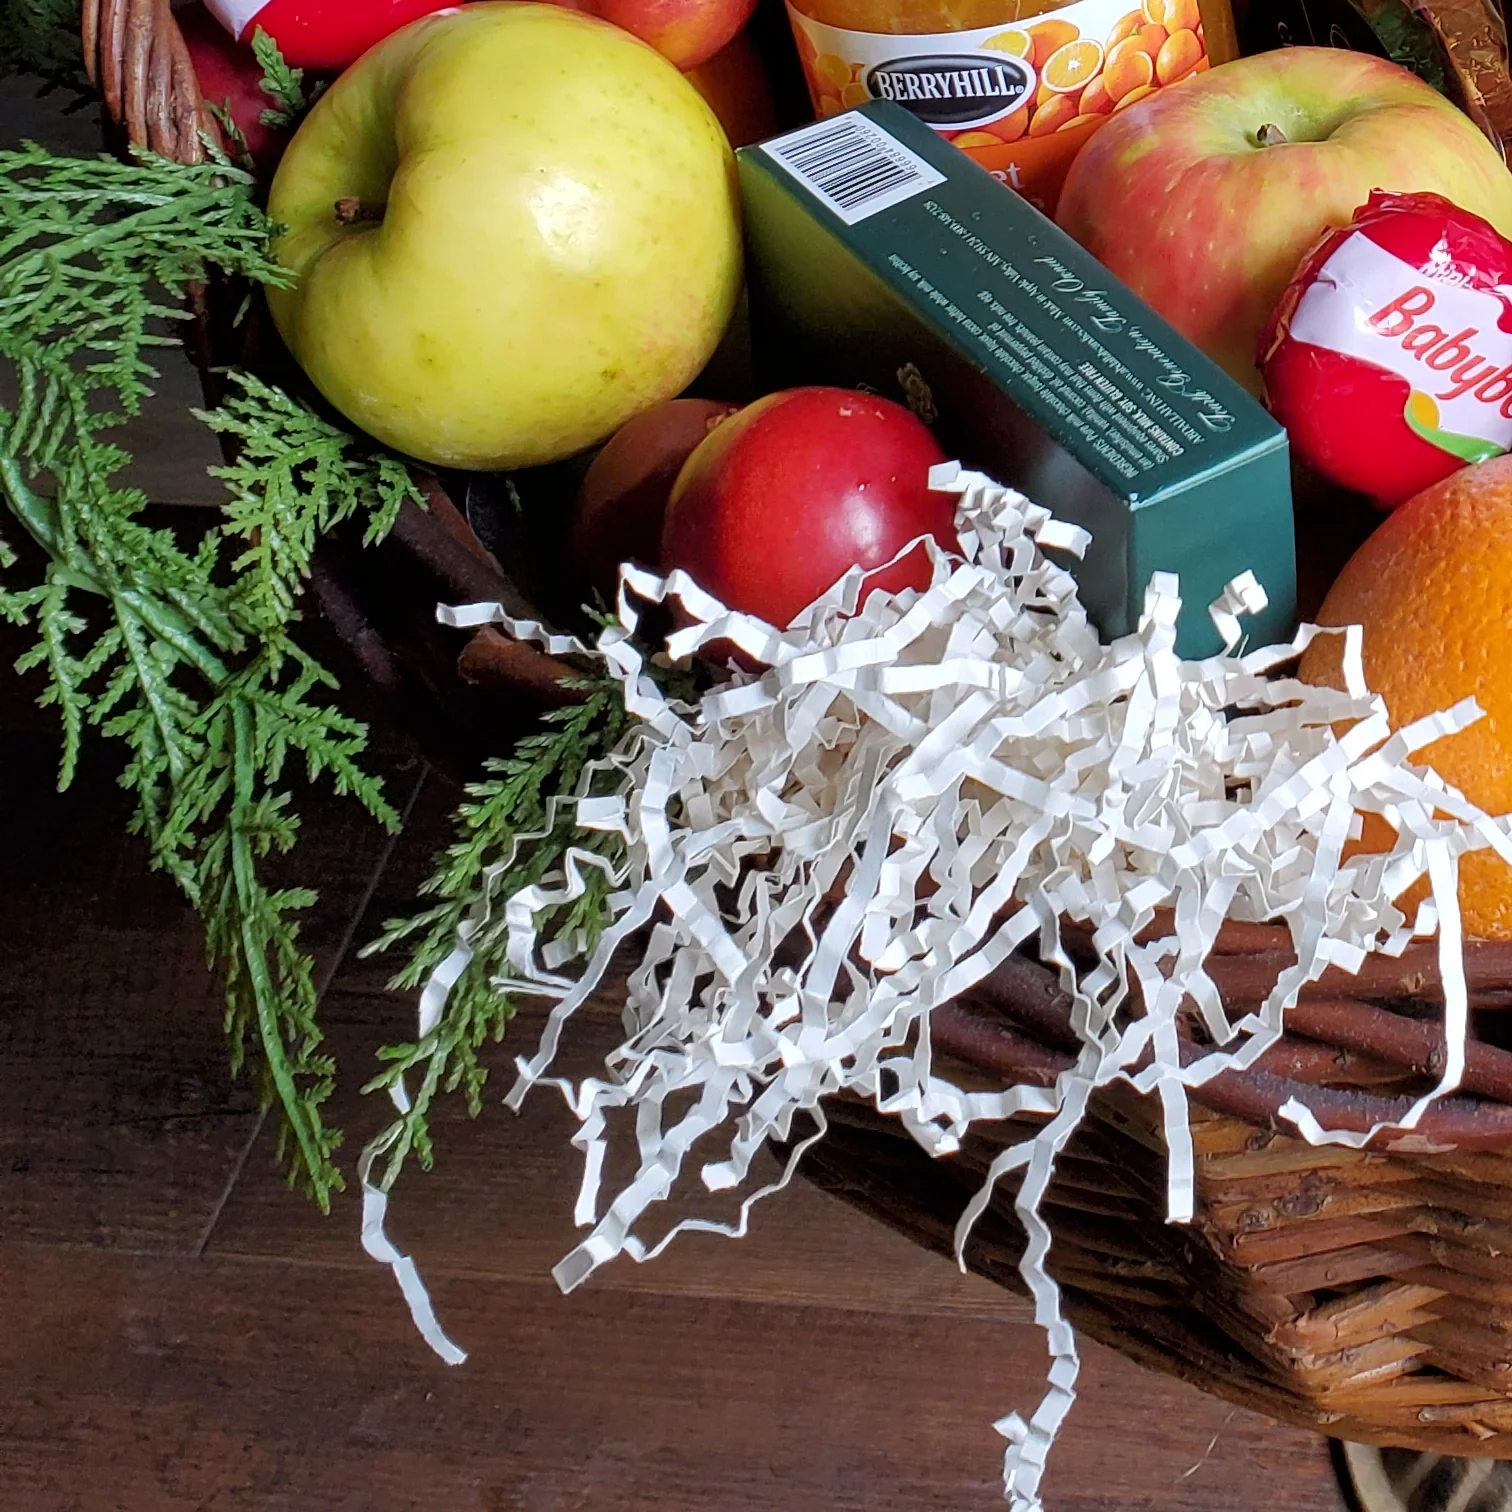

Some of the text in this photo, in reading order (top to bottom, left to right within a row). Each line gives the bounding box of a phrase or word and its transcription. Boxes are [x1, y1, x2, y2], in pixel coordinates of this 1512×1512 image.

[875, 64, 1016, 100] BERRYHILL
[1033, 255, 1084, 291] Owned
[1072, 289, 1127, 331] Family
[1076, 360, 1101, 380] FREE
[1092, 374, 1125, 401] GLUTEN
[1145, 423, 1187, 457] CONTAINS
[1154, 402, 1207, 446] ABDALLAH
